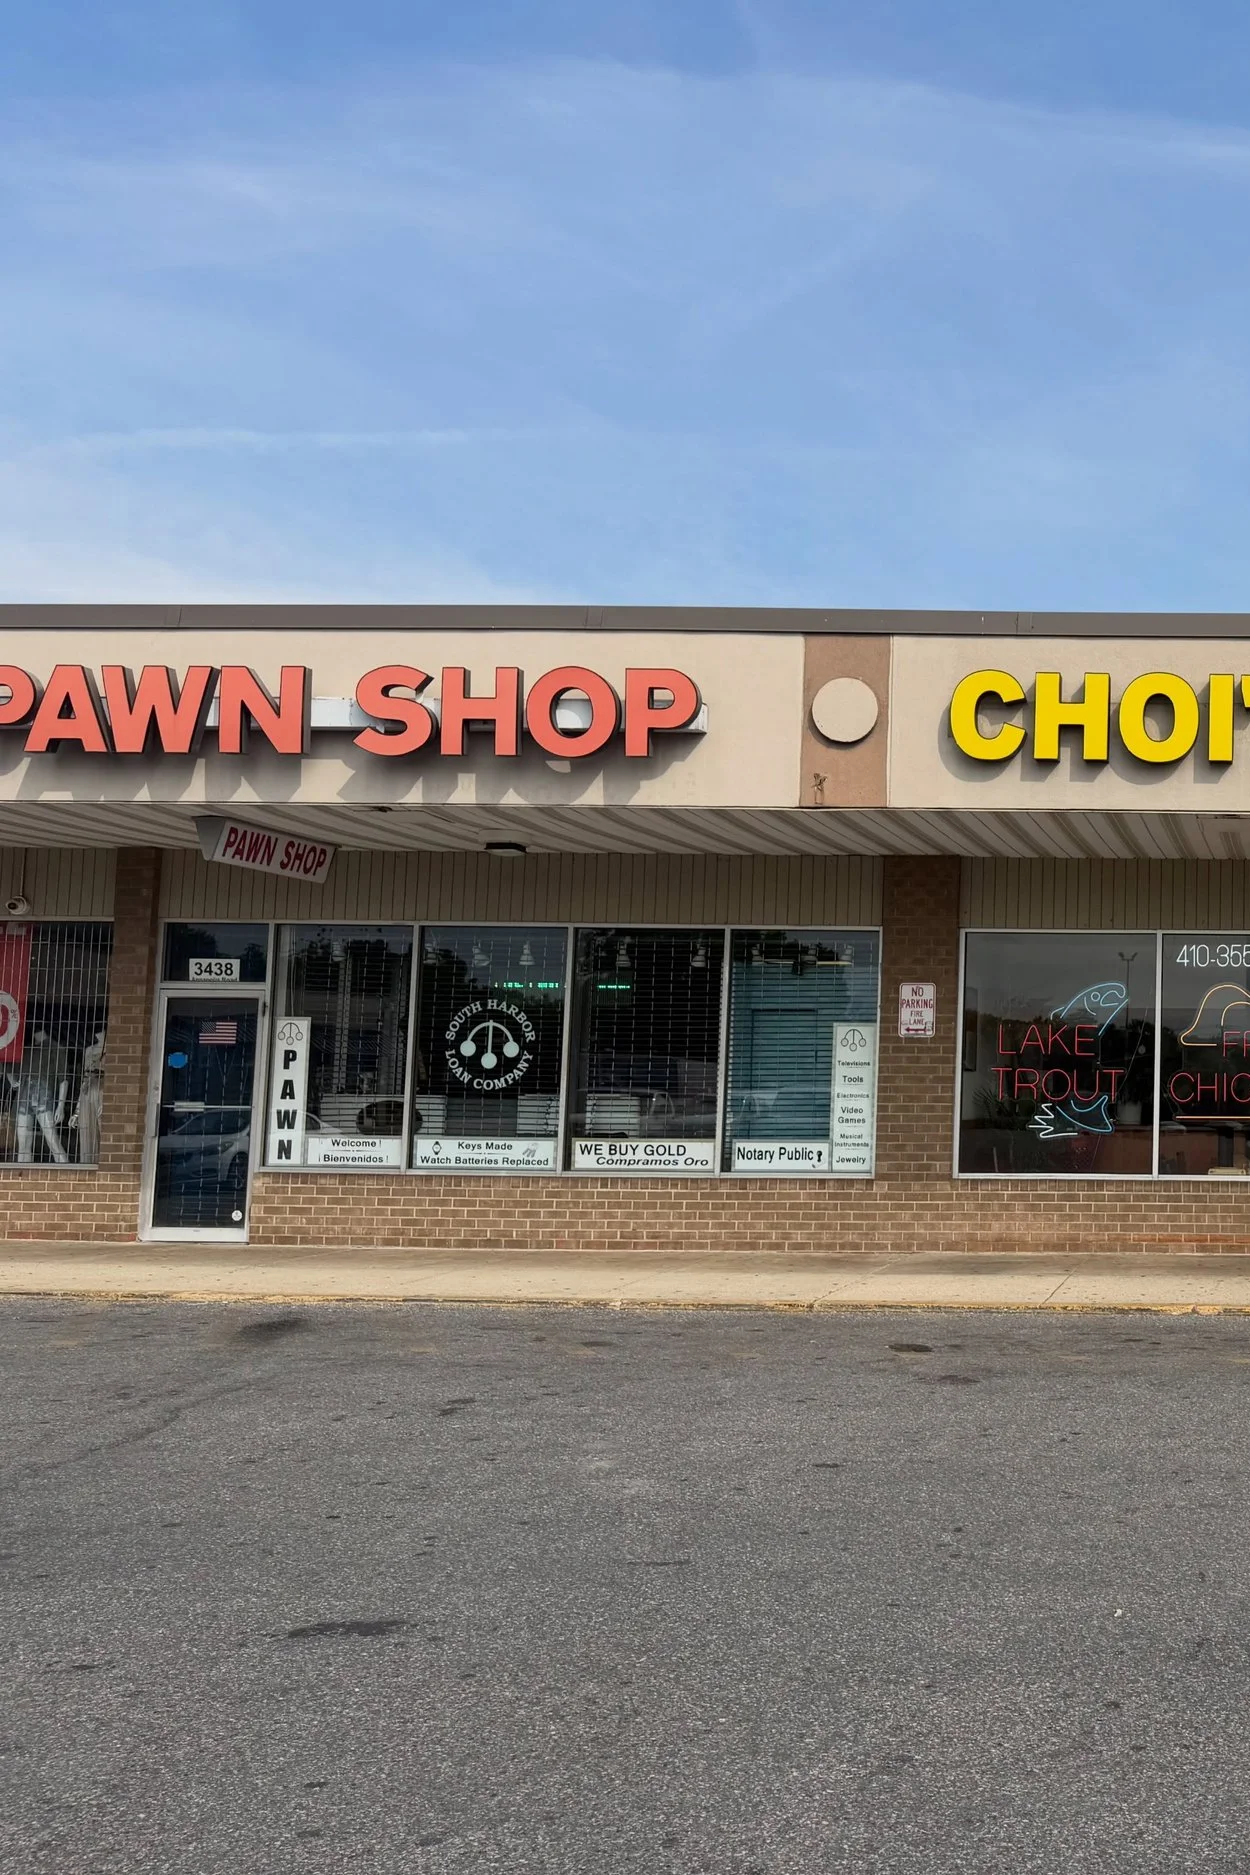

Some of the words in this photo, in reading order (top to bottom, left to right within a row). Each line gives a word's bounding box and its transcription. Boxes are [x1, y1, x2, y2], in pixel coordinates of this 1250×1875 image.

[352, 664, 703, 758] SHOP
[221, 825, 278, 868] PAWN
[278, 839, 328, 877] SHOP
[194, 962, 234, 976] 3438
[911, 987, 924, 997] NO
[901, 999, 933, 1009] PARKING
[910, 1010, 924, 1018] FIRE
[445, 1001, 482, 1041] SOUTH
[487, 999, 537, 1043] HARBOR
[996, 1024, 1100, 1056] LAKE
[445, 1050, 472, 1084] LOAN
[473, 1050, 534, 1091] COMPANY
[842, 1075, 864, 1083] Tools
[991, 1067, 1126, 1103] TROUT
[276, 1050, 298, 1160] PAWN
[458, 1141, 482, 1152] Keys
[485, 1142, 513, 1150] Made
[579, 1144, 603, 1156] WE
[608, 1144, 639, 1156] BUY
[643, 1144, 687, 1156] GOLD
[420, 1156, 451, 1164] Watch
[454, 1156, 499, 1165] Batteries
[502, 1157, 549, 1167] Replaced
[737, 1146, 775, 1164] Notary
[778, 1147, 814, 1161] Public
[835, 1156, 866, 1164] Jewelry
[596, 1157, 679, 1167] Compramos
[683, 1157, 709, 1166] Oro
